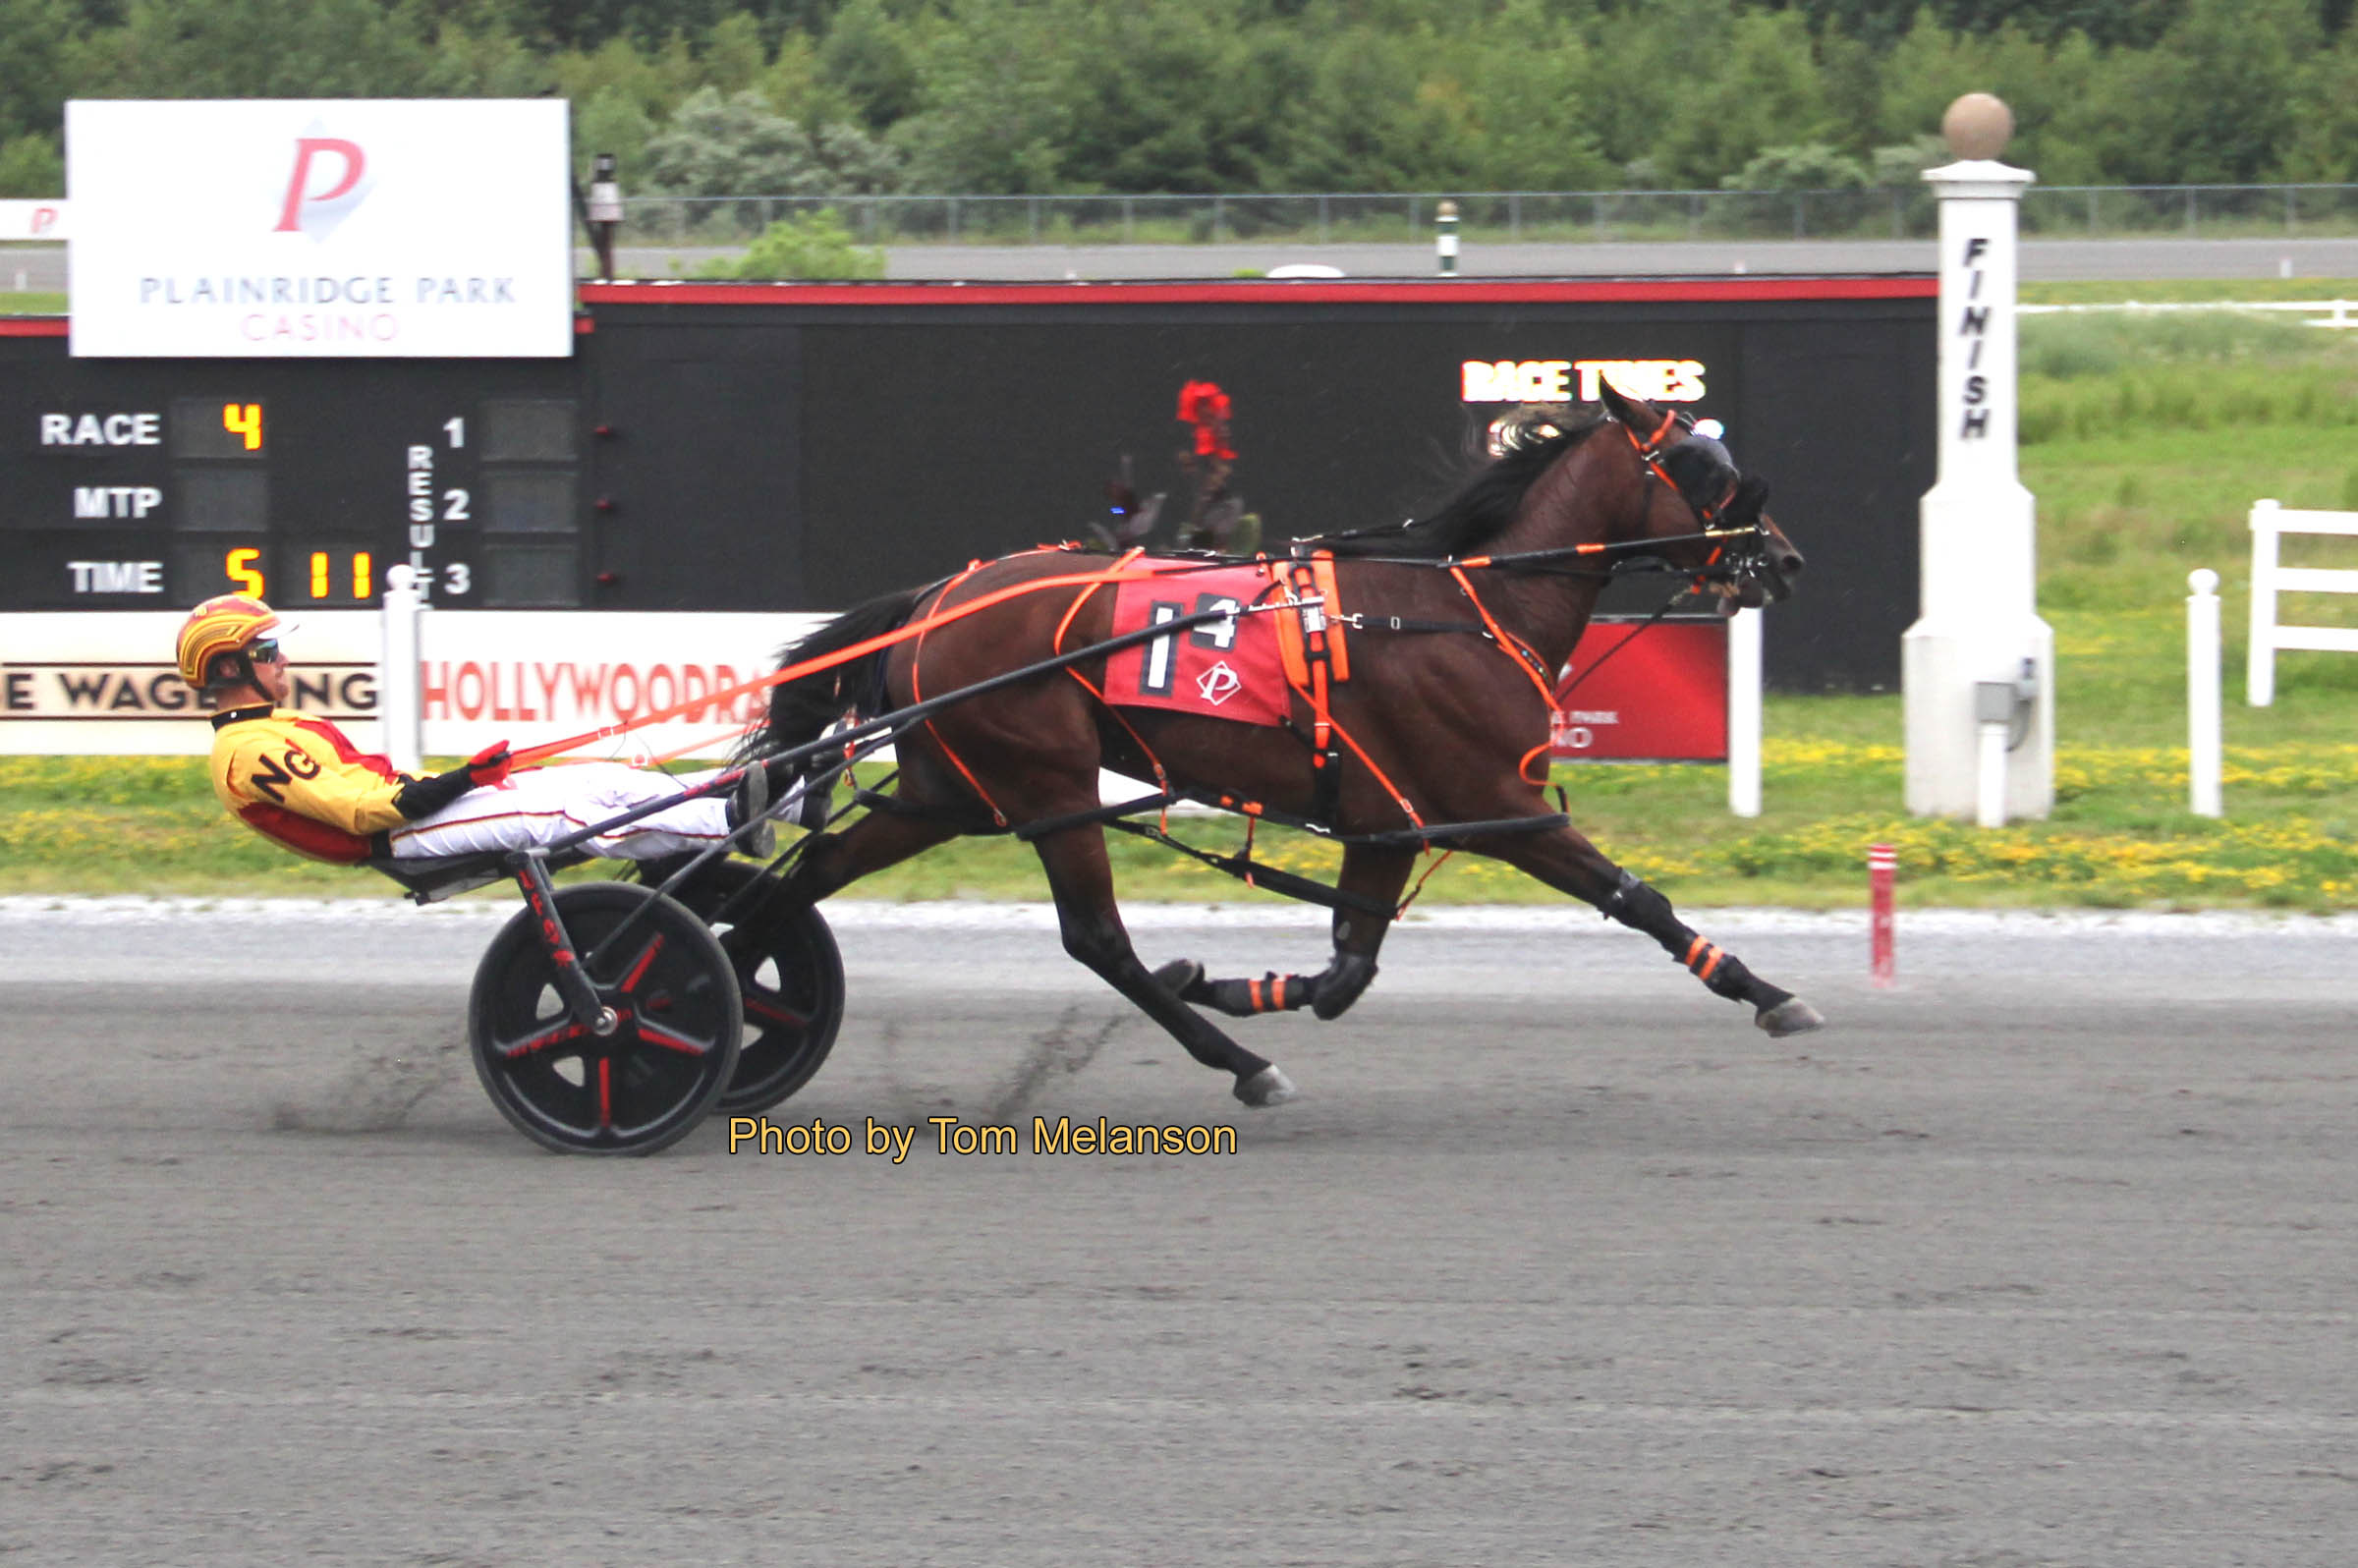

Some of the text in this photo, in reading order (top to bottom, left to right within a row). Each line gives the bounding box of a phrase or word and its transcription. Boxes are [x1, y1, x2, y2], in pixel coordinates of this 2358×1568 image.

[273, 138, 367, 232] P
[140, 277, 516, 305] PLAINRIDGE PARK
[241, 313, 397, 342] CASINO
[1960, 238, 1991, 439] FINISH
[1463, 361, 1572, 402] RACE
[41, 414, 160, 445] RACE
[223, 404, 261, 450] 4
[444, 418, 465, 448] 1
[74, 487, 162, 519] MTP
[443, 489, 471, 521] 2
[67, 562, 163, 592] TIME
[226, 548, 264, 600] 5
[444, 562, 471, 594] 3
[57, 673, 377, 710] WAGENG
[252, 749, 321, 803] NG
